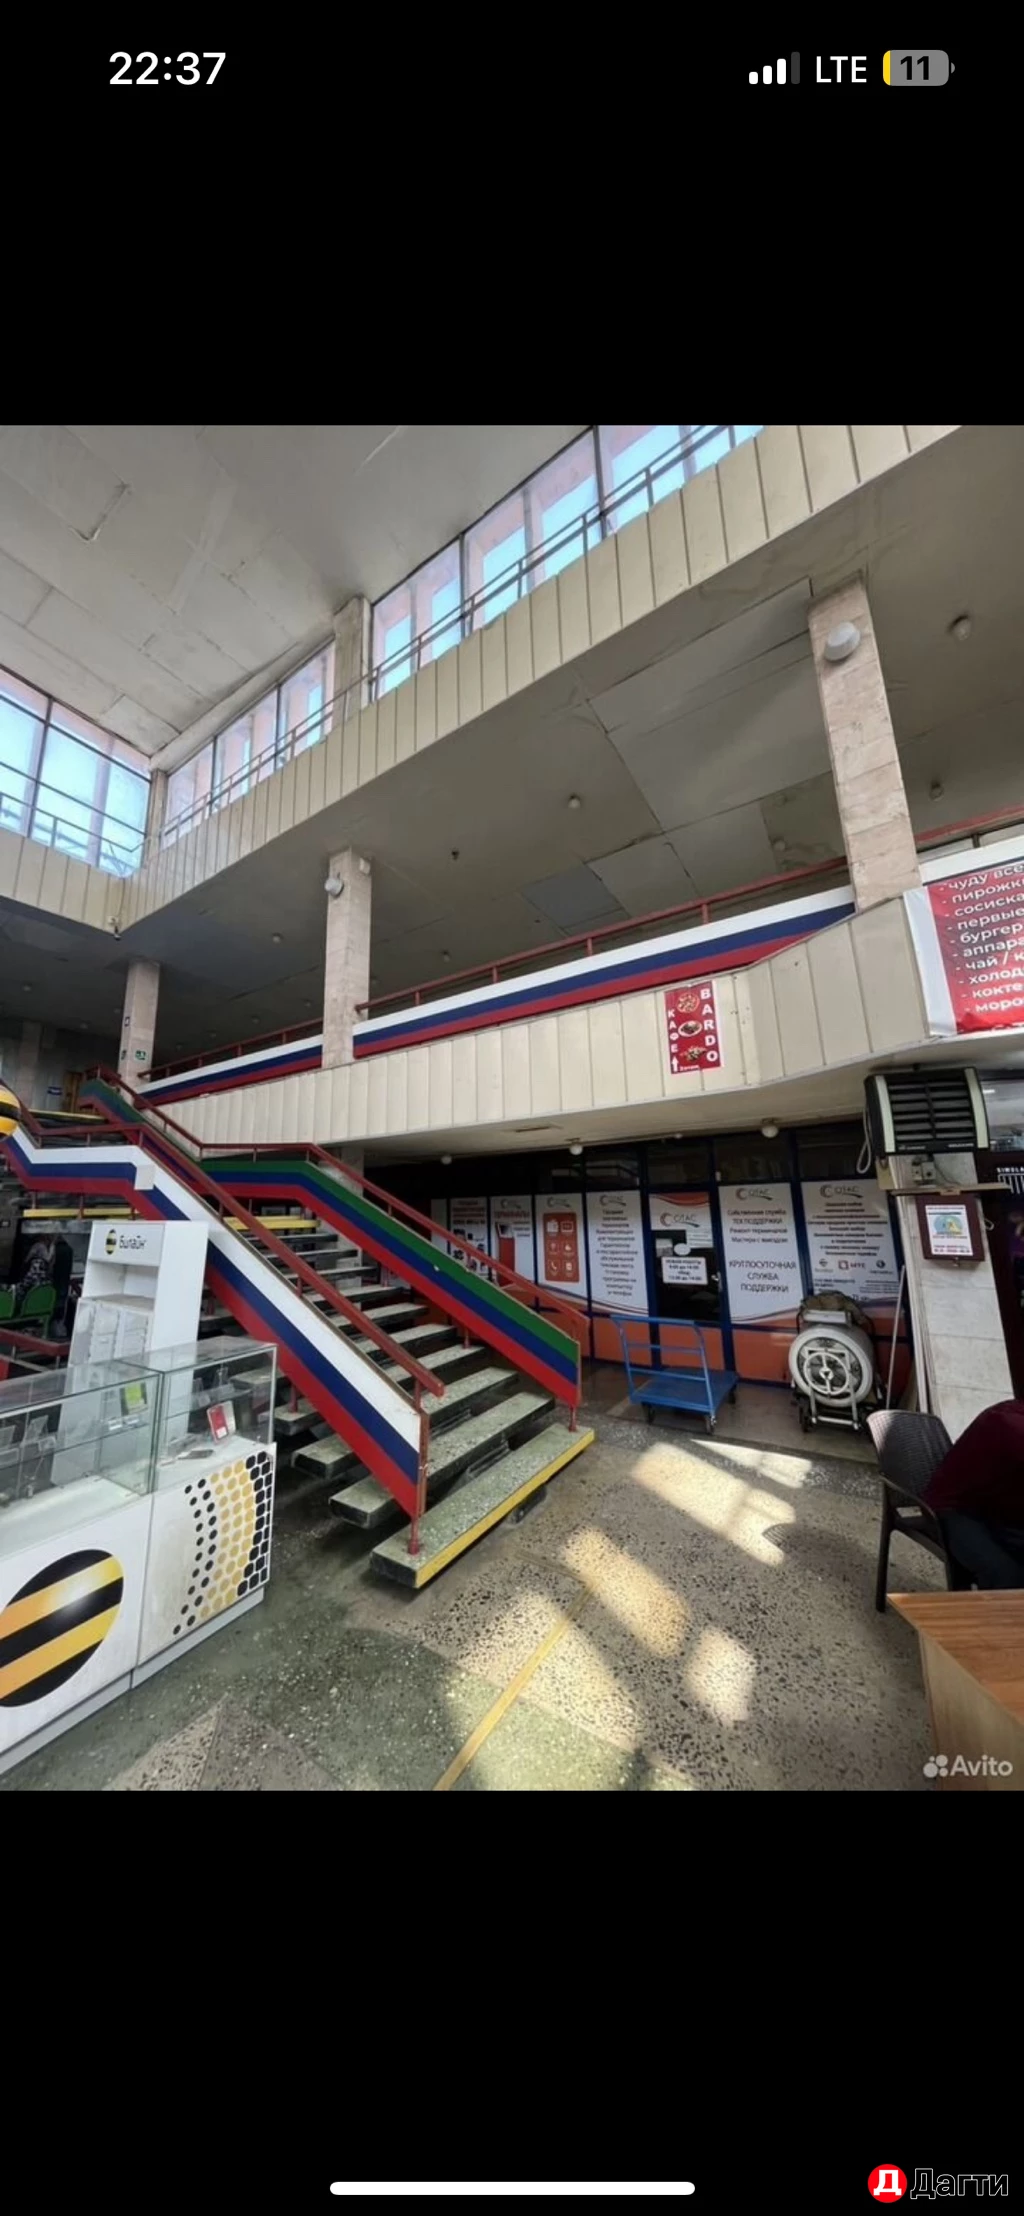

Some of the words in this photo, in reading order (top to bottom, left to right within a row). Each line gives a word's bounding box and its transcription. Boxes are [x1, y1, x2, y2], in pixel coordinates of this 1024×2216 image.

[948, 874, 988, 891] чуду
[952, 878, 1024, 904] пирожк
[957, 907, 1024, 931] первые
[960, 923, 1023, 944] бургер
[965, 955, 998, 970] чай
[667, 1008, 679, 1053] КАФЕ
[700, 988, 718, 1062] BARDO
[729, 1261, 797, 1270] КРУГЛОСУТОЧНАЯ
[747, 1272, 779, 1281] СЛУЖБА
[740, 1283, 789, 1293] ПОДДЕРЖКИ
